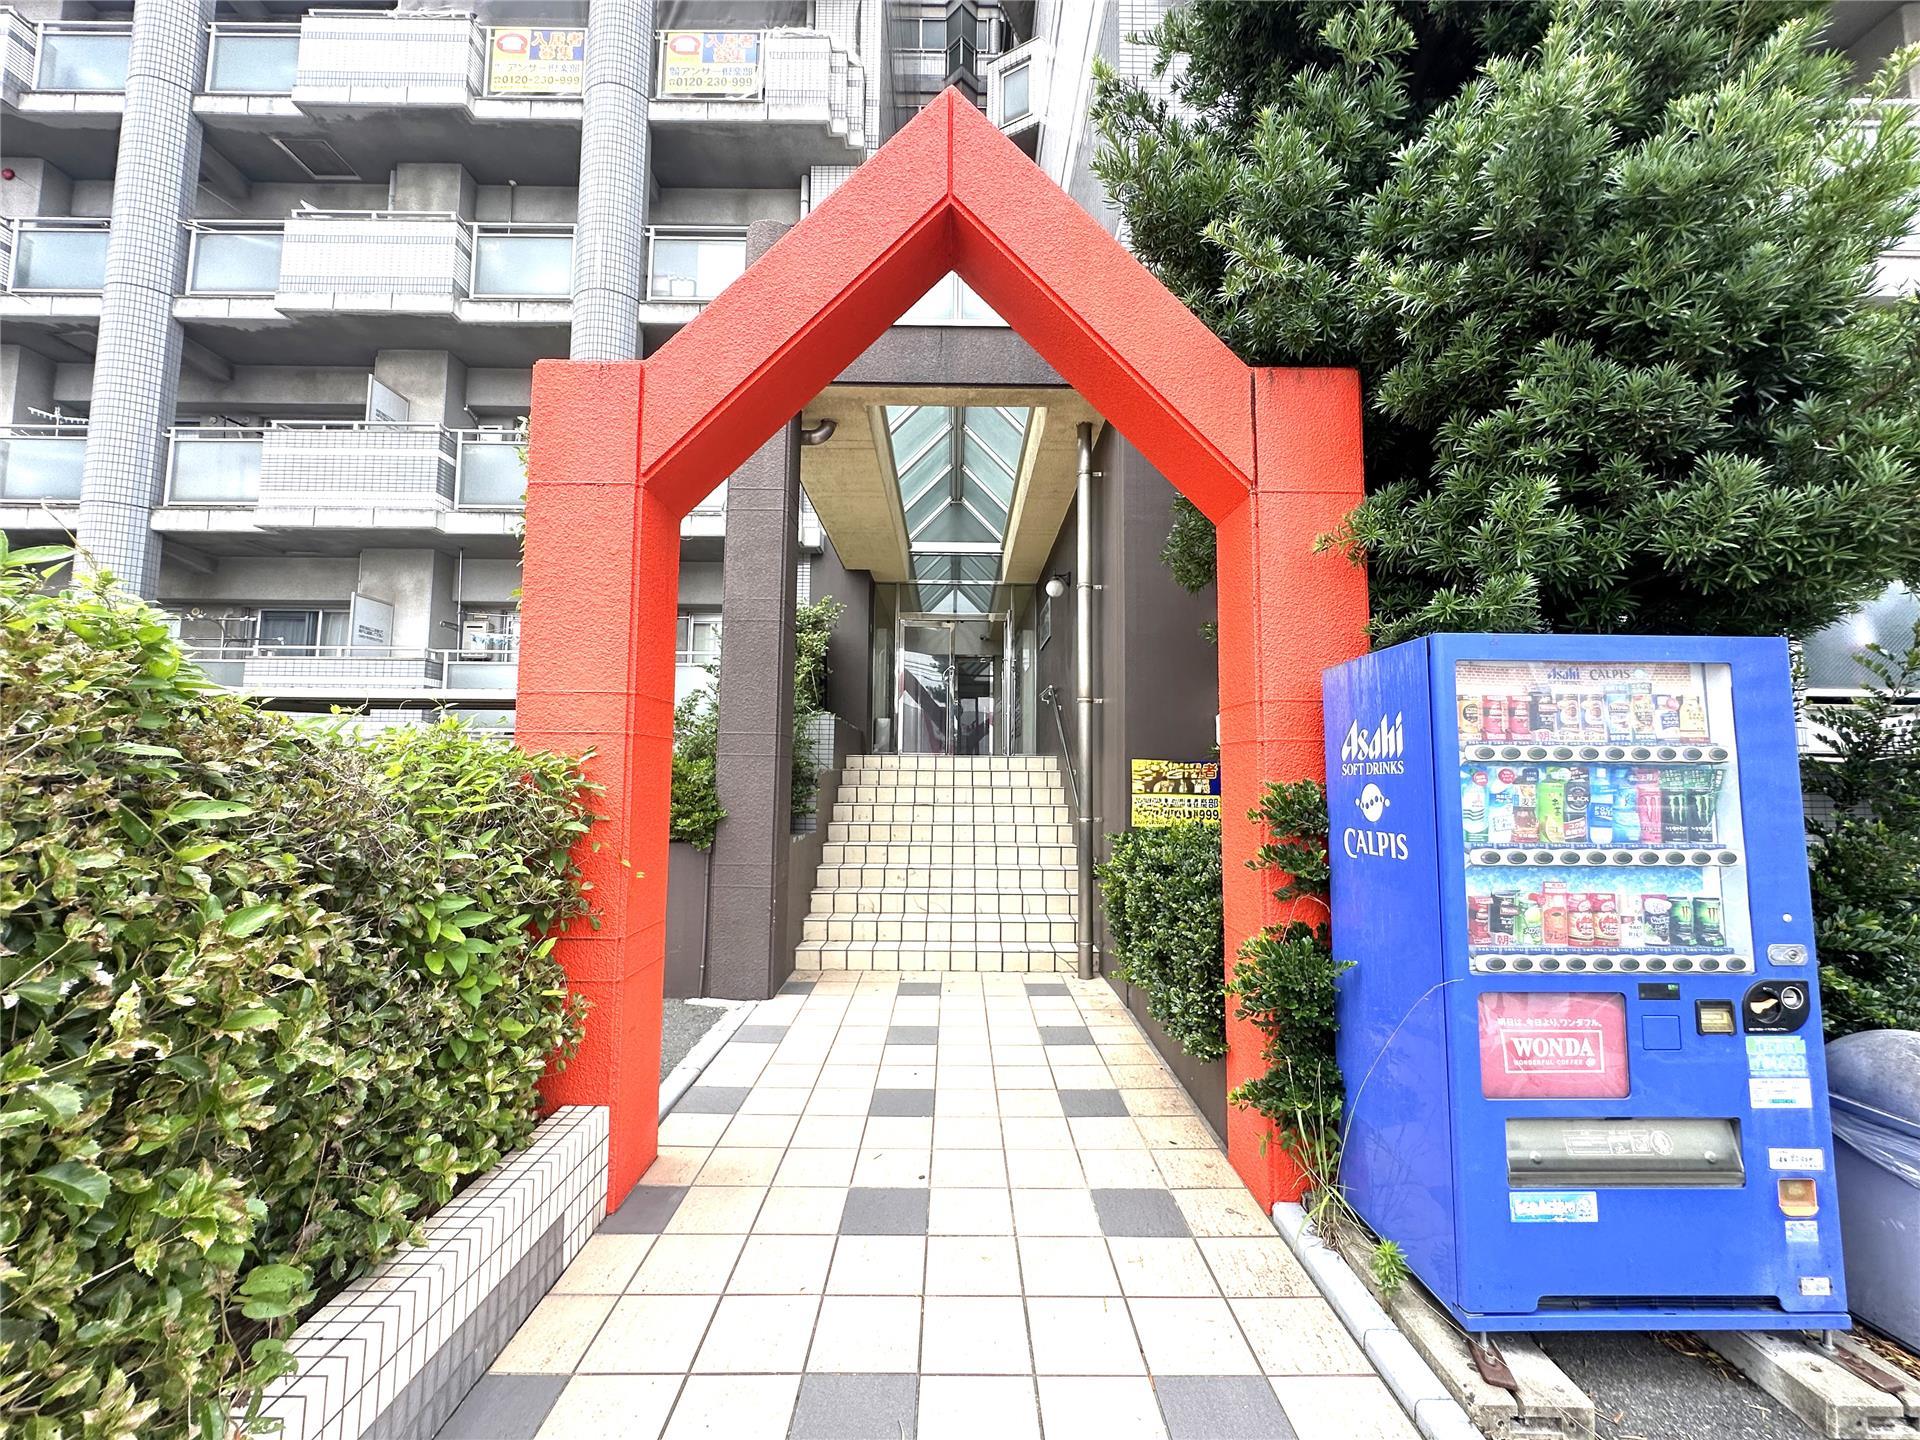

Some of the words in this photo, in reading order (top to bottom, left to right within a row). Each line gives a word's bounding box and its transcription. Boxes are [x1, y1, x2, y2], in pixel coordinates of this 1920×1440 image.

[1547, 666, 1580, 681] Asahi
[1589, 669, 1631, 681] CALPIS
[1341, 711, 1404, 762] Asahi
[1341, 762, 1365, 776] SOFT
[1366, 760, 1405, 776] DRINKS
[1343, 826, 1409, 861] CALPIS
[1510, 1037, 1595, 1058] WONDA
